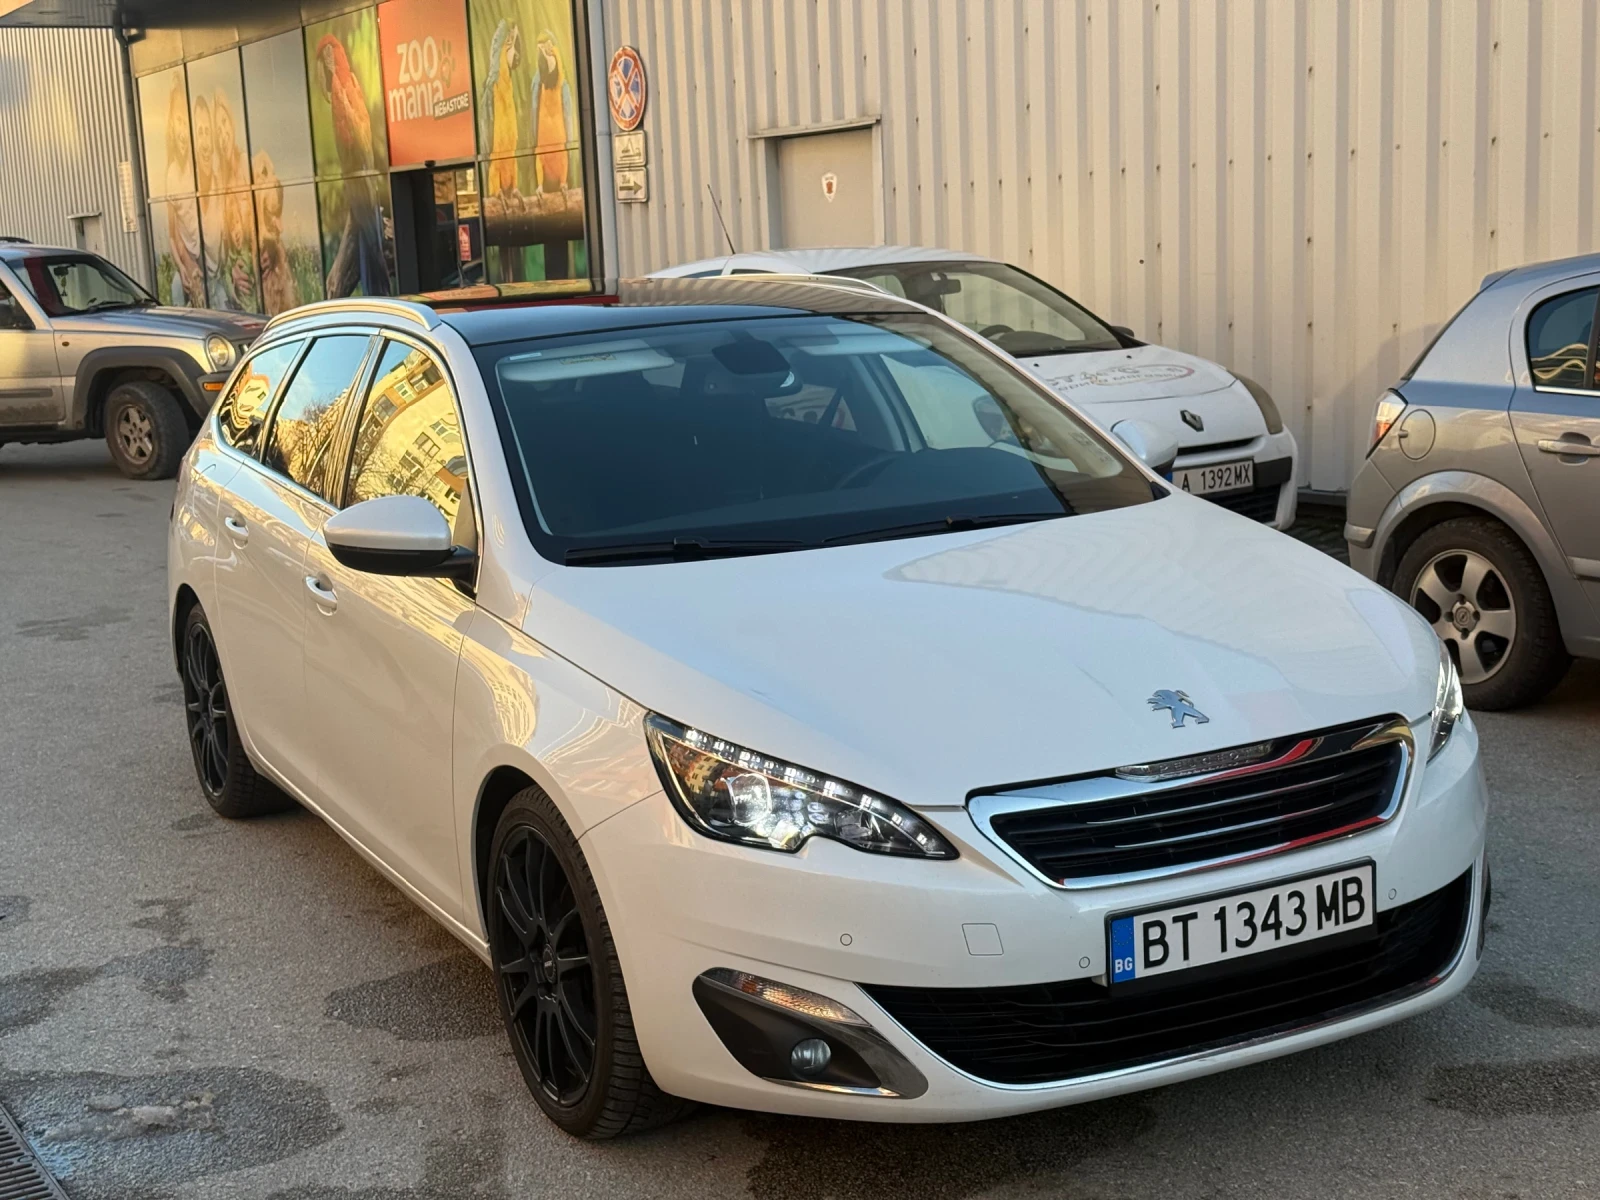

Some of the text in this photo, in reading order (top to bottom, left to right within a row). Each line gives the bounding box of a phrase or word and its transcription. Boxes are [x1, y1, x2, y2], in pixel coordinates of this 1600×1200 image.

[388, 80, 444, 122] mania
[434, 93, 469, 117] MEGASTORE
[1181, 463, 1251, 492] A 1392 MX
[1142, 875, 1366, 969] BT 1343 MB
[1114, 957, 1134, 973] BG
